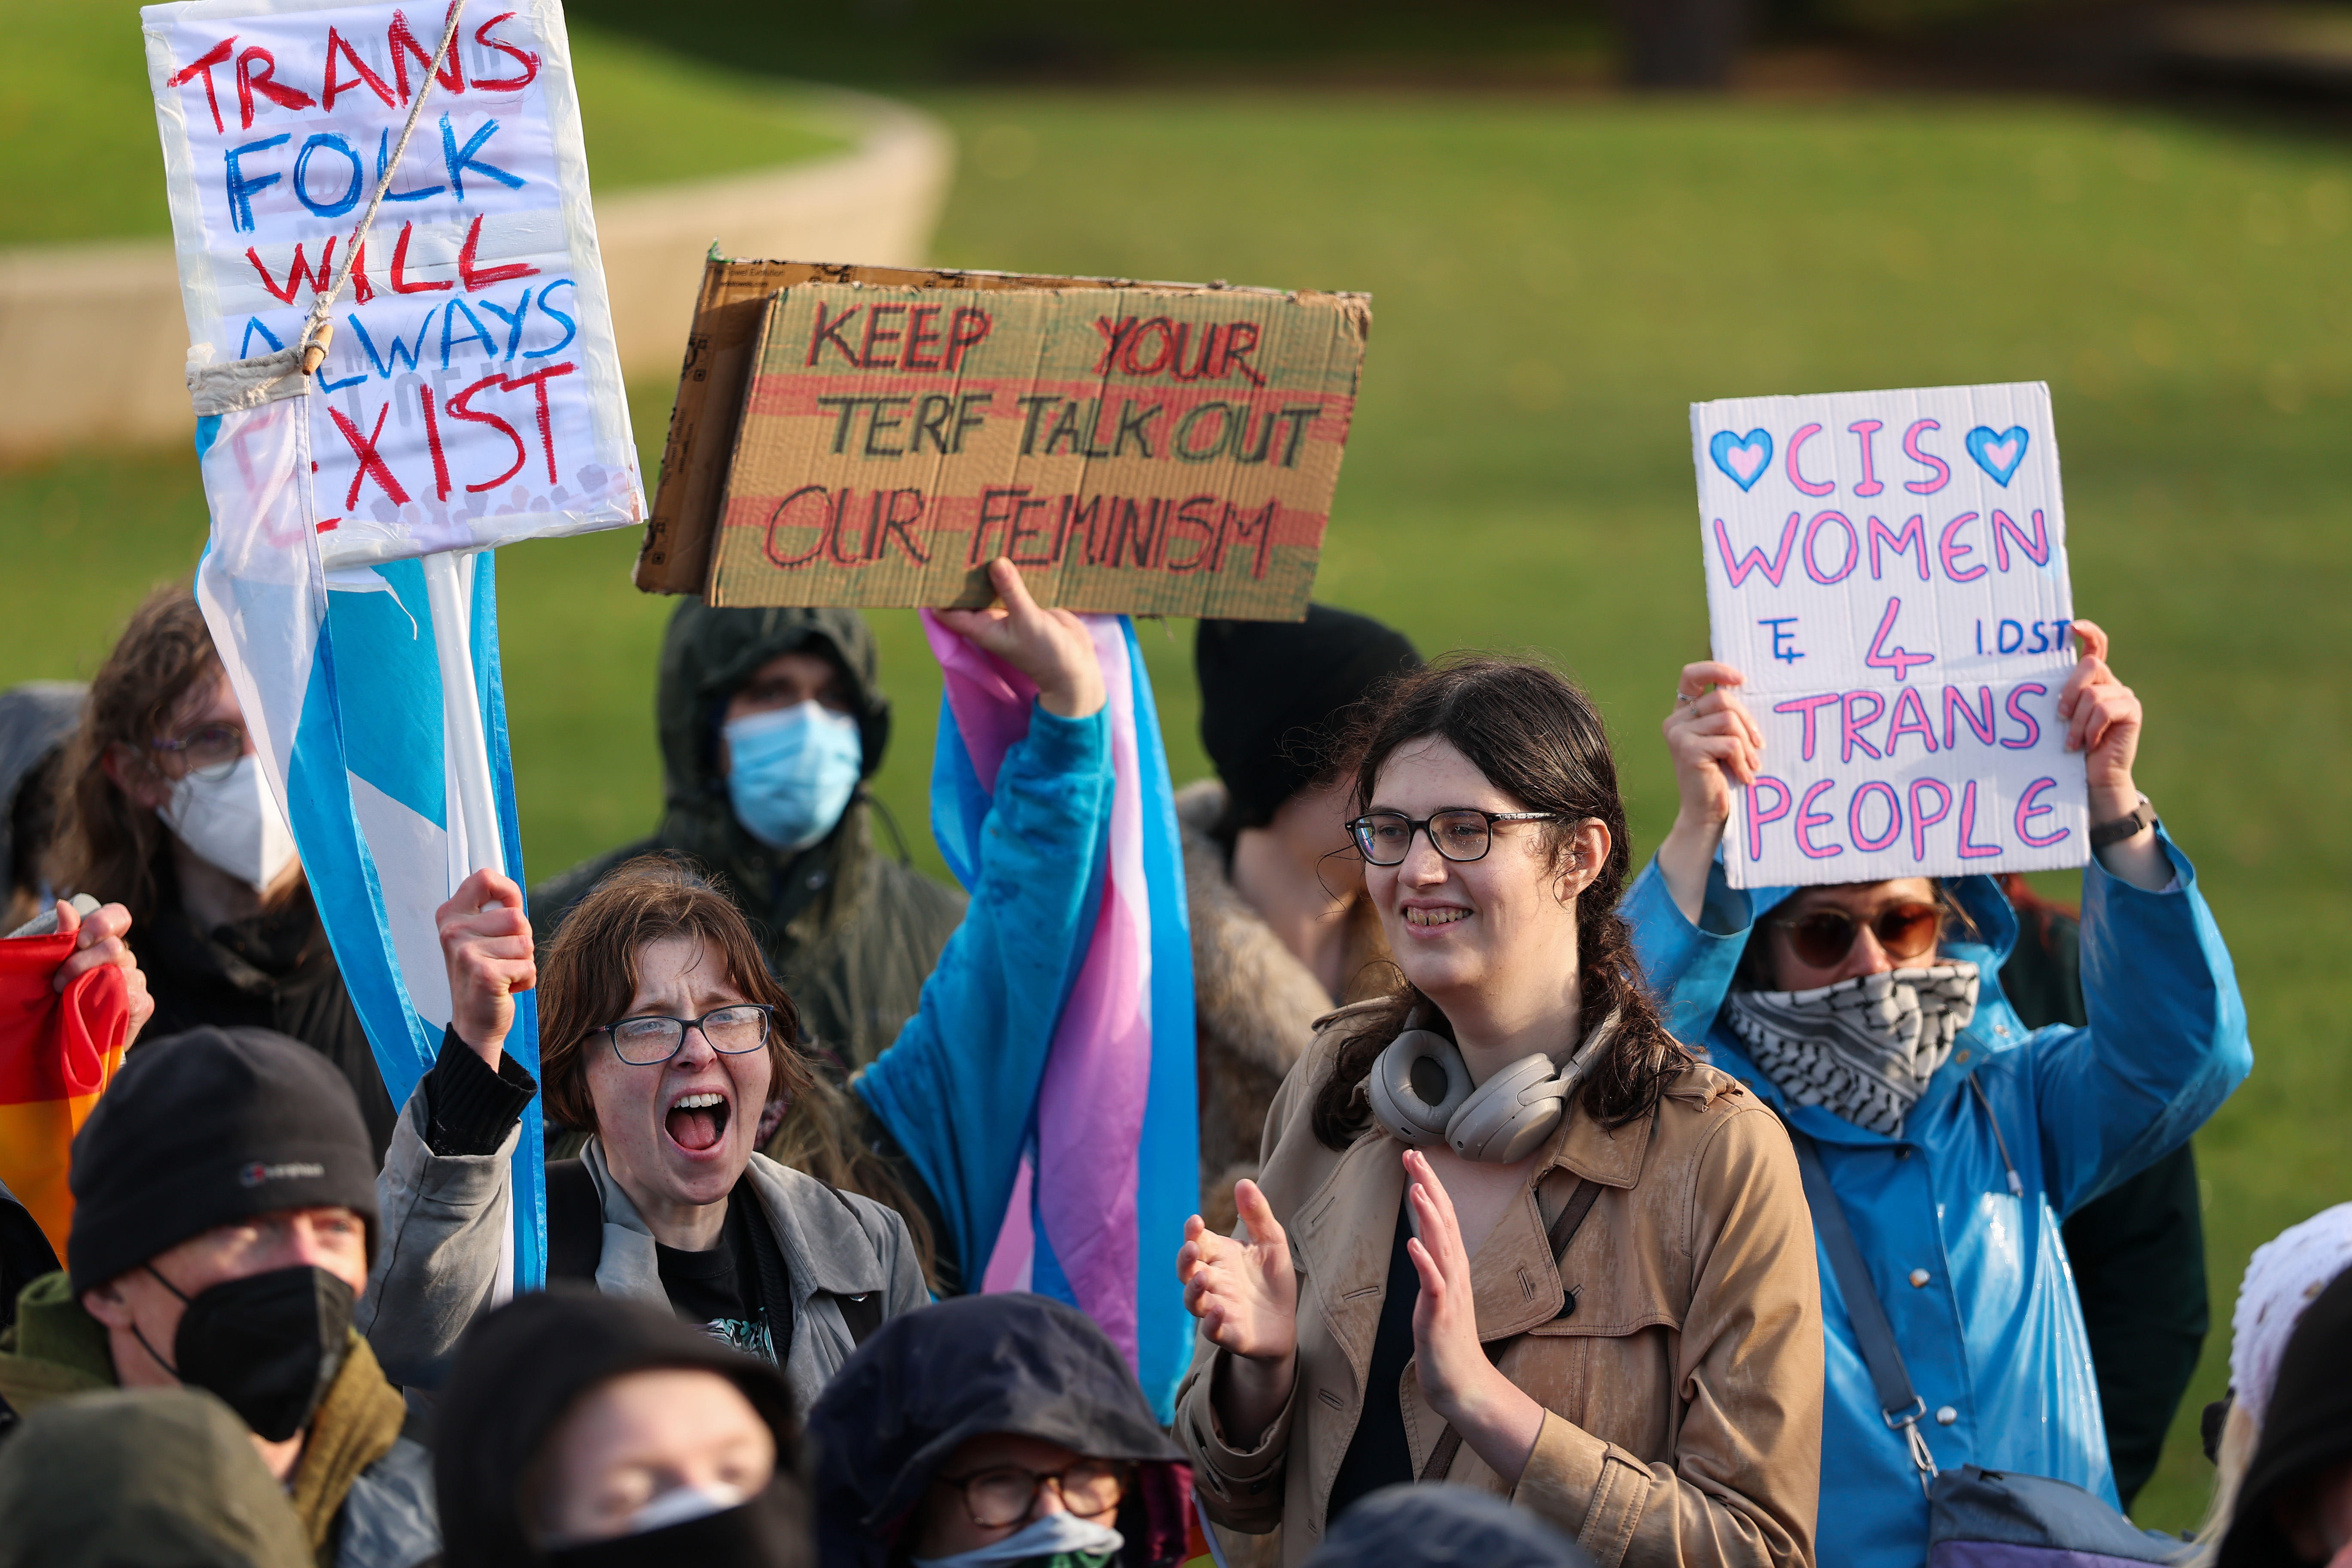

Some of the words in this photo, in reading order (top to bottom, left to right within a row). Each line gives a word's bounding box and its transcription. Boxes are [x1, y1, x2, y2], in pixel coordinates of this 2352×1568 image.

[167, 0, 542, 134] TRANS
[224, 111, 530, 234] FOLK
[245, 213, 541, 305] WILL
[805, 301, 992, 373] KEEP
[1091, 314, 1266, 388] YOUR
[817, 393, 992, 457] TERF
[1017, 396, 1163, 460] TALK
[1171, 400, 1322, 467] OUT
[1786, 419, 1950, 497] CIS
[762, 484, 931, 570] OUR
[965, 485, 1281, 580] FEMINISM
[1714, 510, 2050, 588] WOMEN
[1866, 597, 1934, 680] 4
[1774, 683, 2047, 762] TRANS
[1746, 776, 2070, 862] PEOPLE
